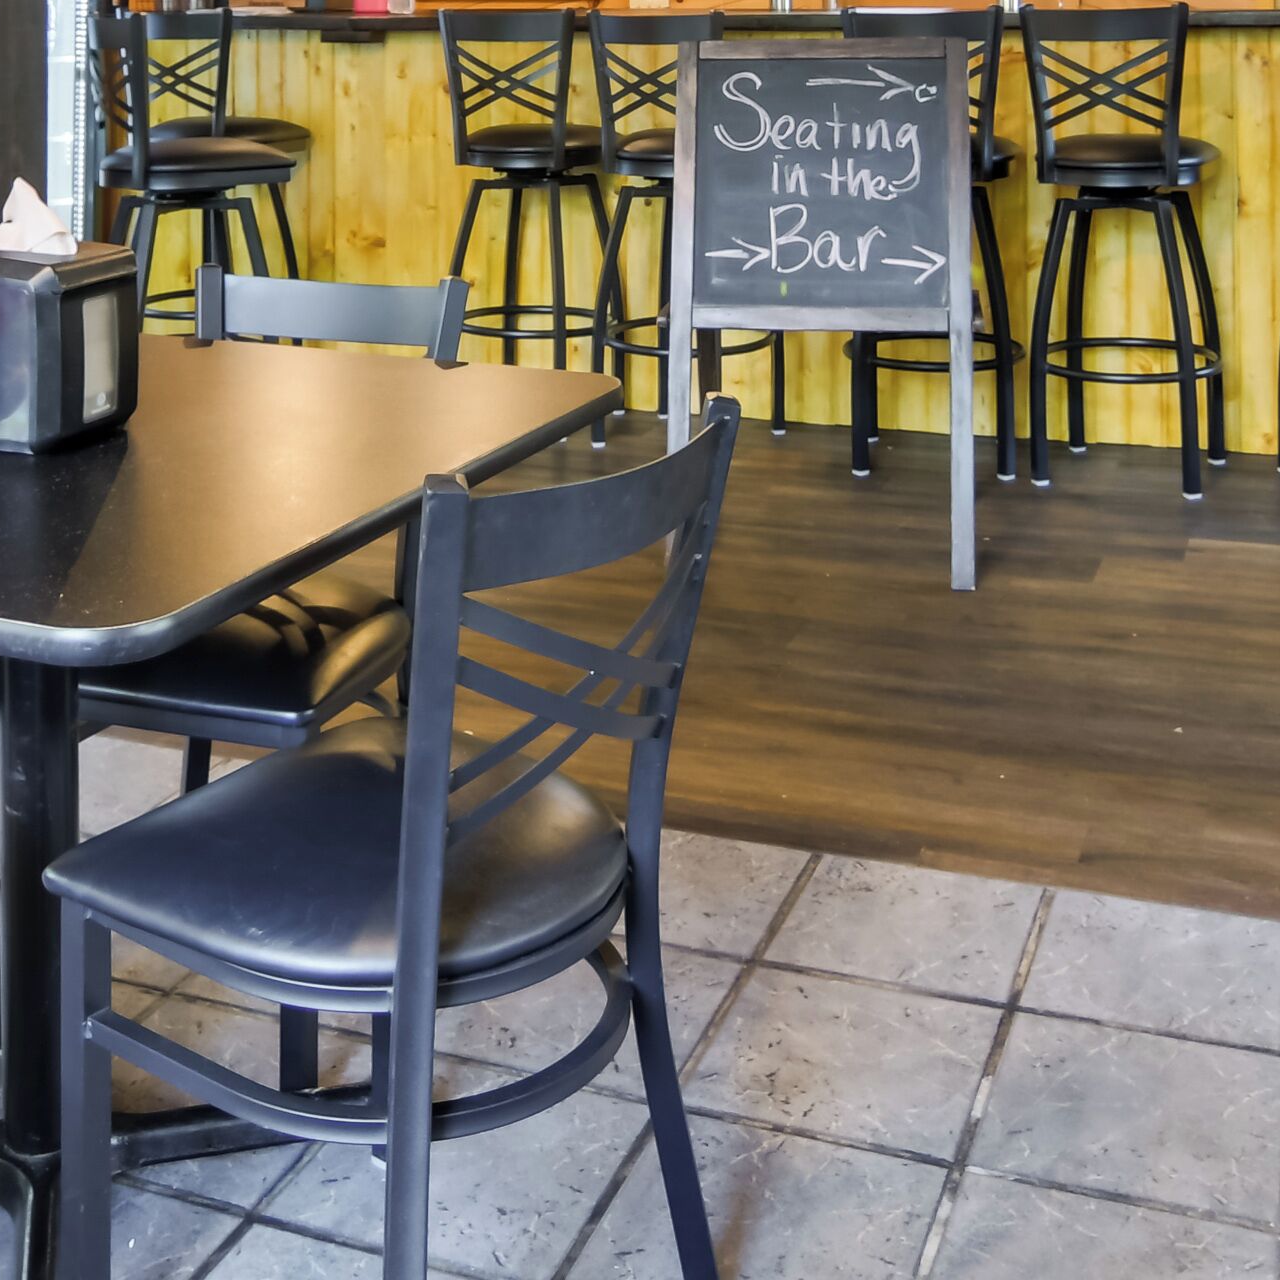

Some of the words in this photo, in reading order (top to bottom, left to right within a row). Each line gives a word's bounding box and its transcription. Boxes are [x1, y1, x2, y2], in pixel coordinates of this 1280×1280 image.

[714, 71, 922, 193] Seating
[771, 155, 809, 196] in
[821, 156, 898, 201] the
[768, 204, 887, 274] Bar
